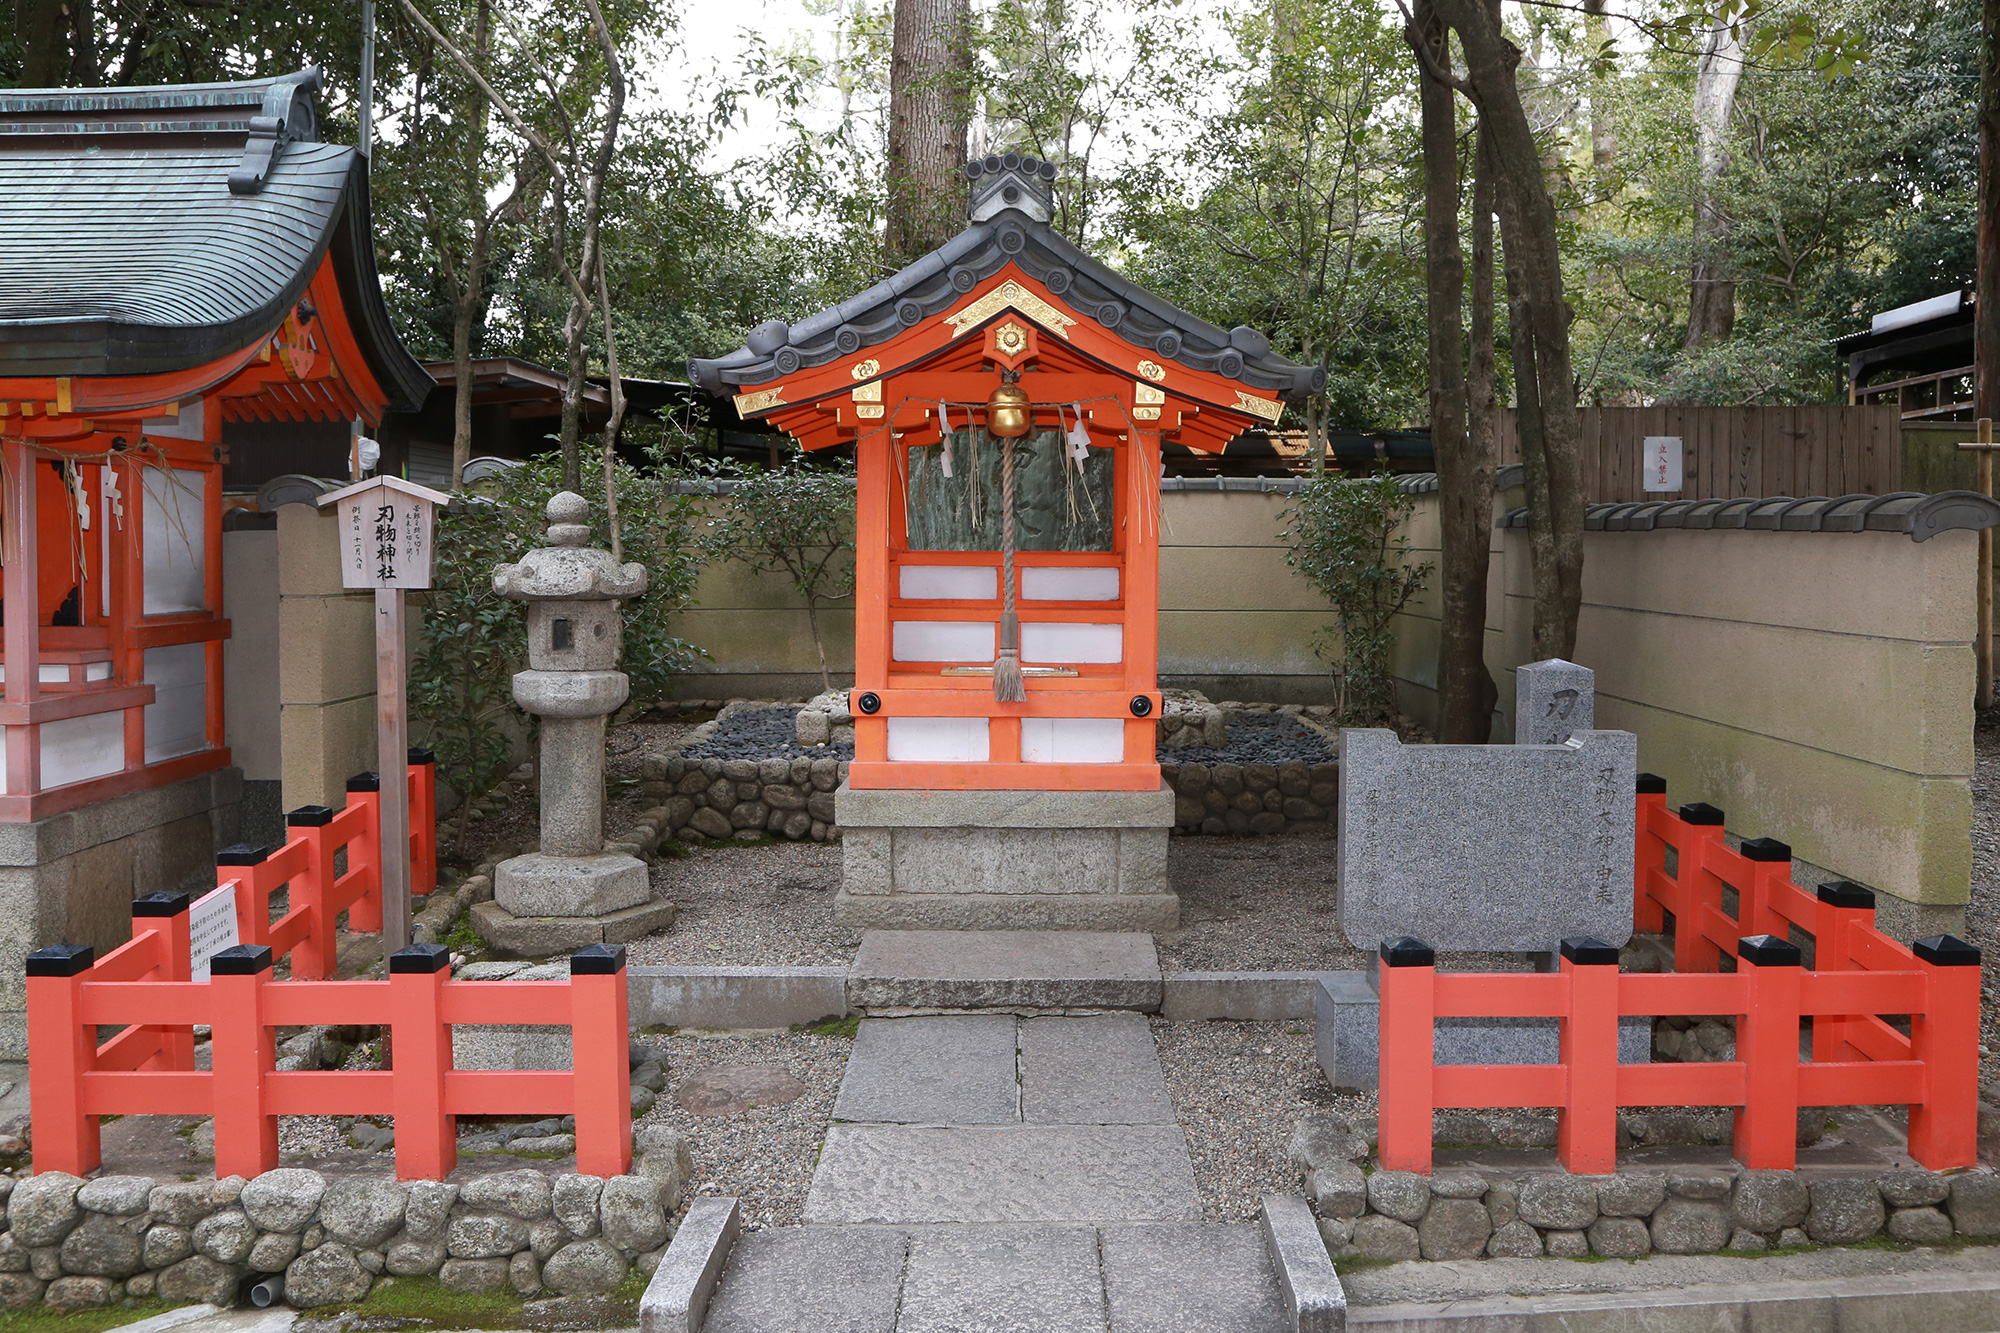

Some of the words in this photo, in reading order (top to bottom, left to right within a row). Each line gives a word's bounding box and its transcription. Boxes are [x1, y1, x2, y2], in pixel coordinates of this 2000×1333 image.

[1658, 444, 1667, 485] 立入禁止
[352, 506, 361, 531] 例祭日
[353, 537, 362, 570] 十一月八日
[374, 504, 397, 581] 刃物神社
[1594, 767, 1617, 906] 刃物大神の由来
[190, 902, 232, 933] 染症予防のため手水舎の
